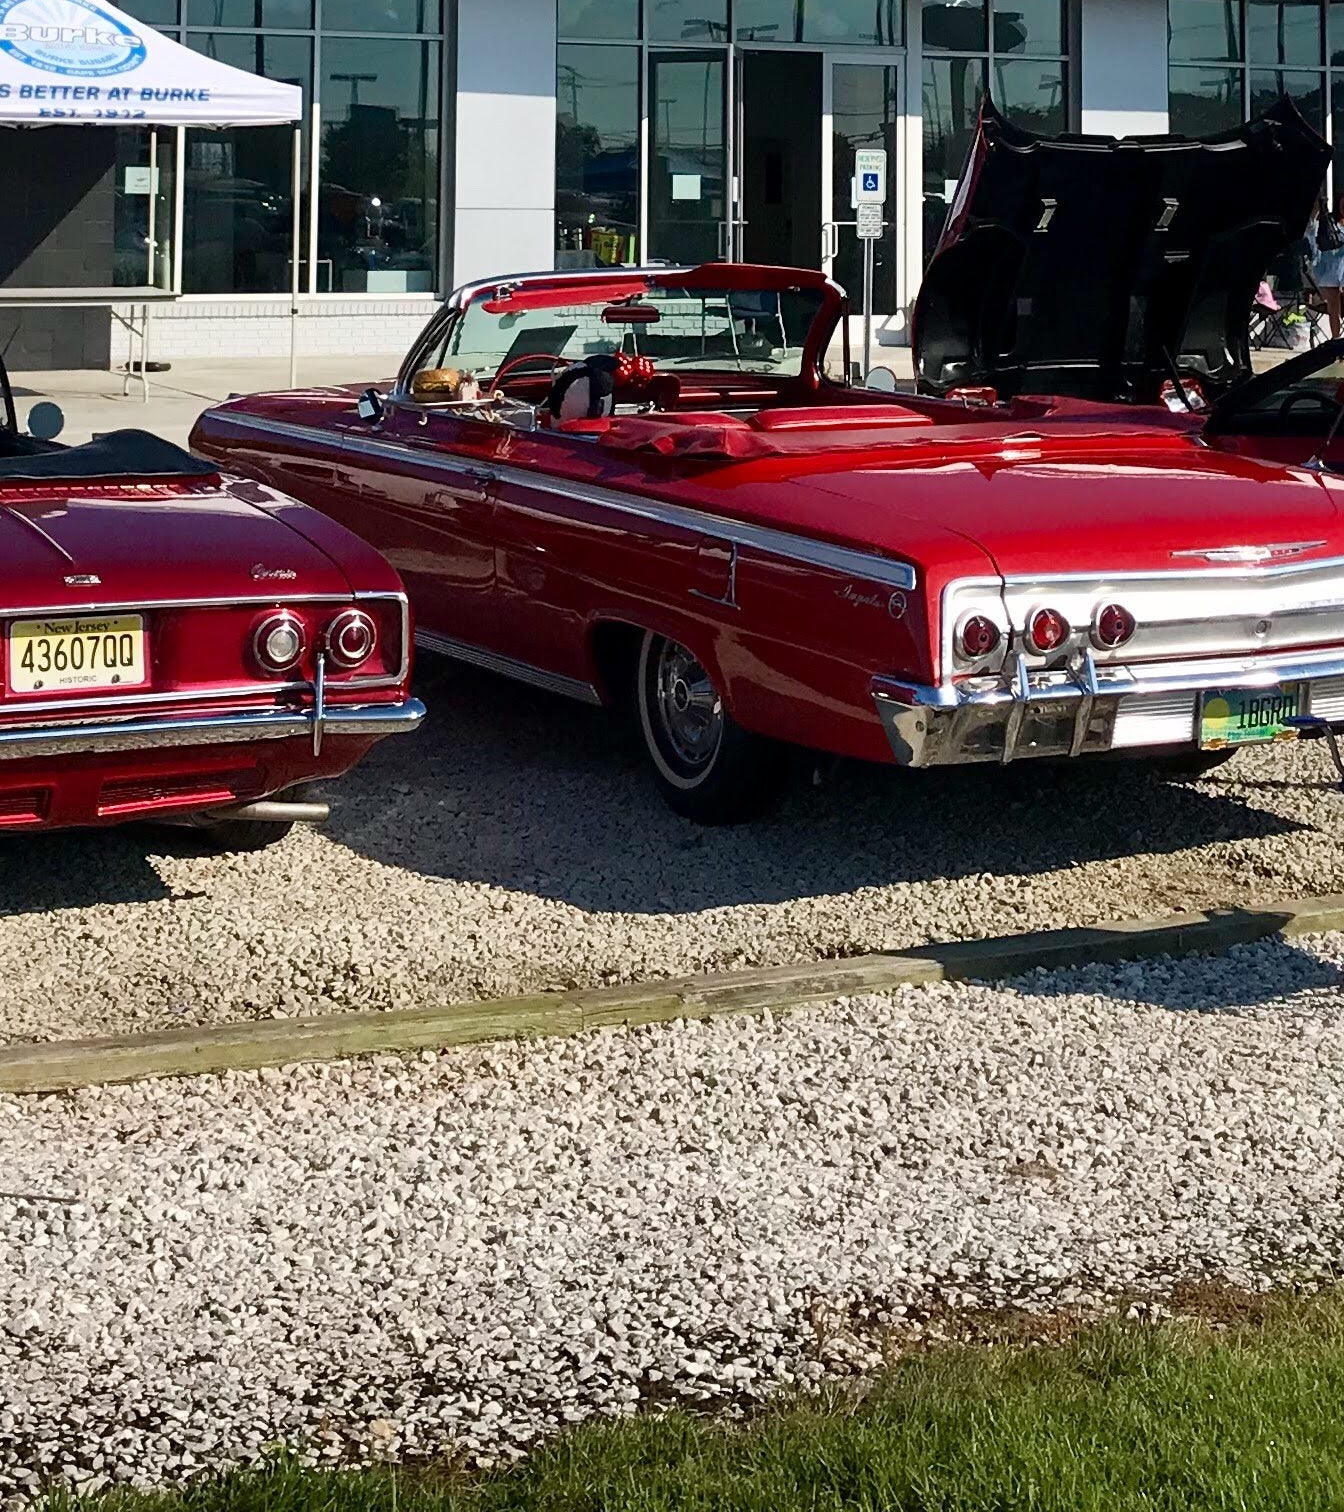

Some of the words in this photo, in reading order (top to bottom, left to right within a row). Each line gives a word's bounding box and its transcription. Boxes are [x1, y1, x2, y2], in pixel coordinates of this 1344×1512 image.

[19, 84, 100, 100] BETTER
[107, 86, 132, 101] AT
[140, 87, 210, 102] BURKE
[44, 622, 72, 634] New
[74, 620, 111, 635] Jersey
[21, 633, 134, 673] 43607QQ
[59, 675, 97, 684] HISTORIC
